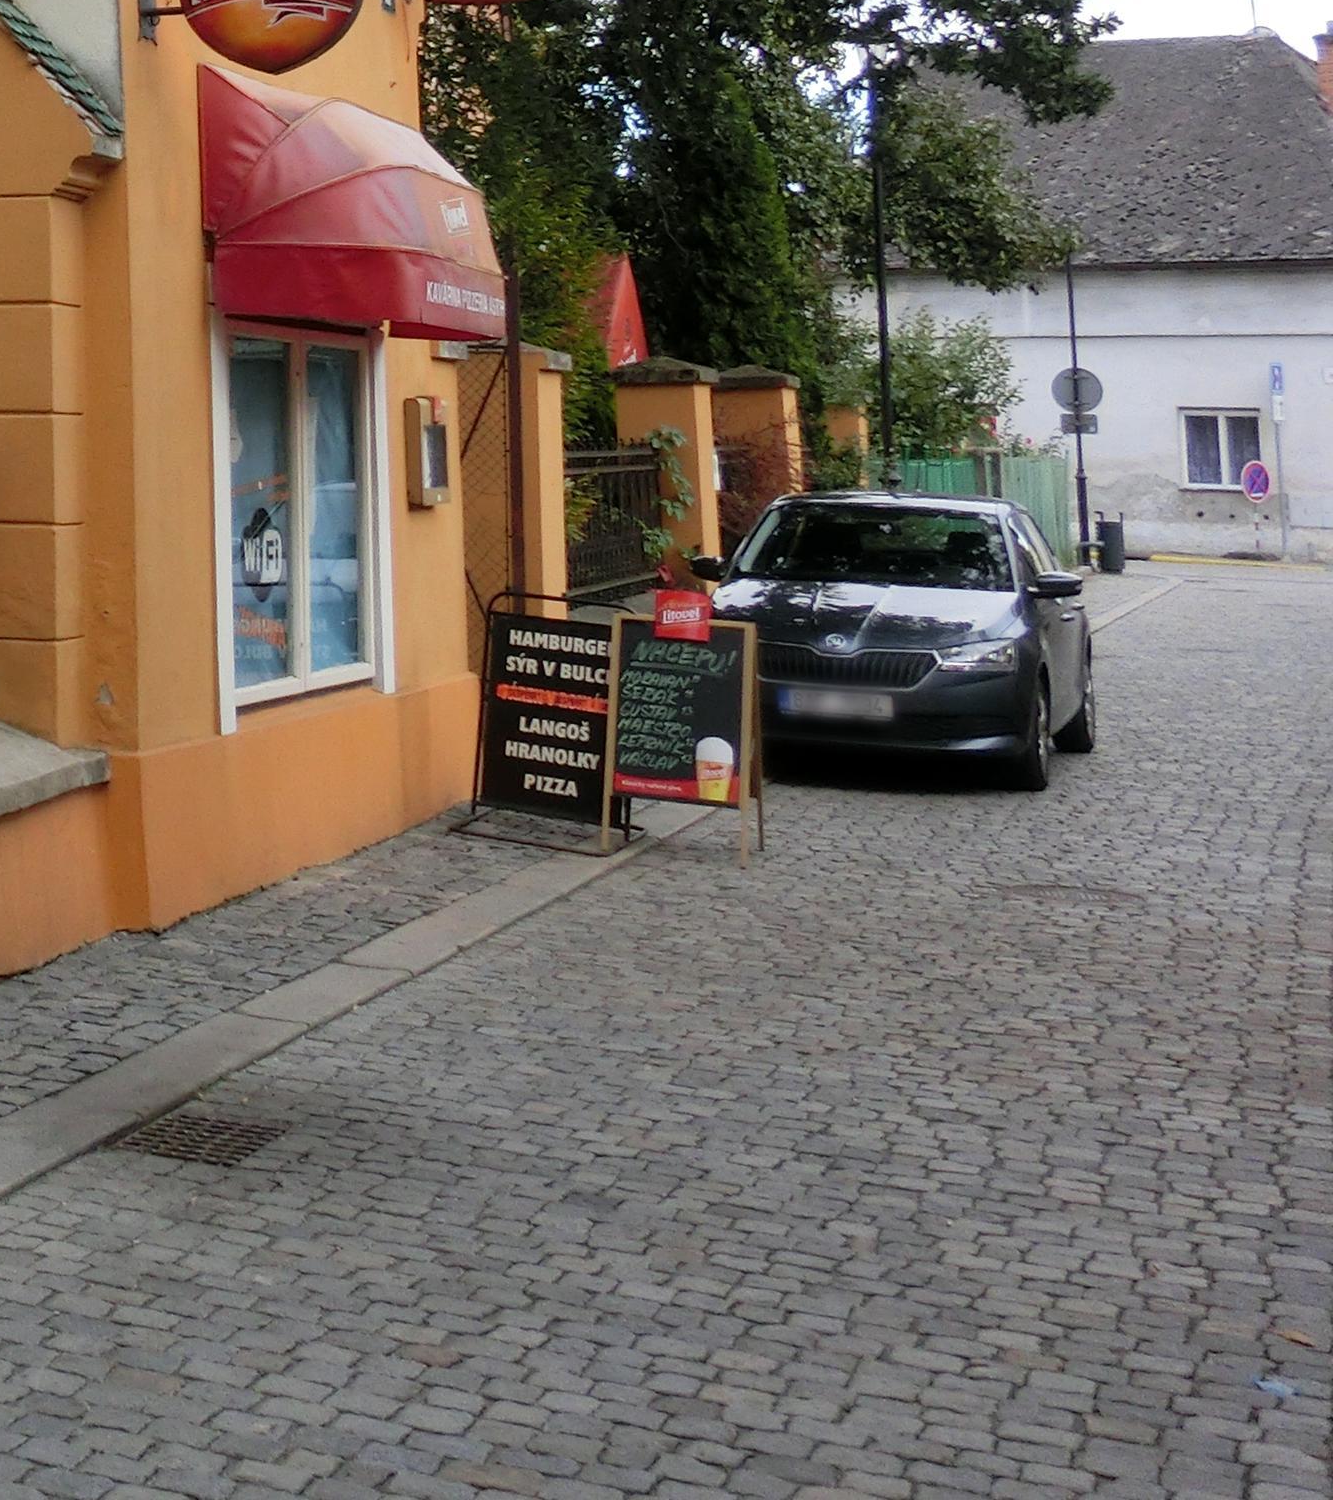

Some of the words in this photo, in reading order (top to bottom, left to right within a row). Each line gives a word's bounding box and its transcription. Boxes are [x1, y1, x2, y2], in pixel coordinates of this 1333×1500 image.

[506, 652, 538, 675] SÝR
[542, 660, 557, 677] V
[519, 716, 590, 742] LANGOŠ
[505, 740, 600, 770] HRANOLKY
[523, 773, 578, 798] PIZZA
